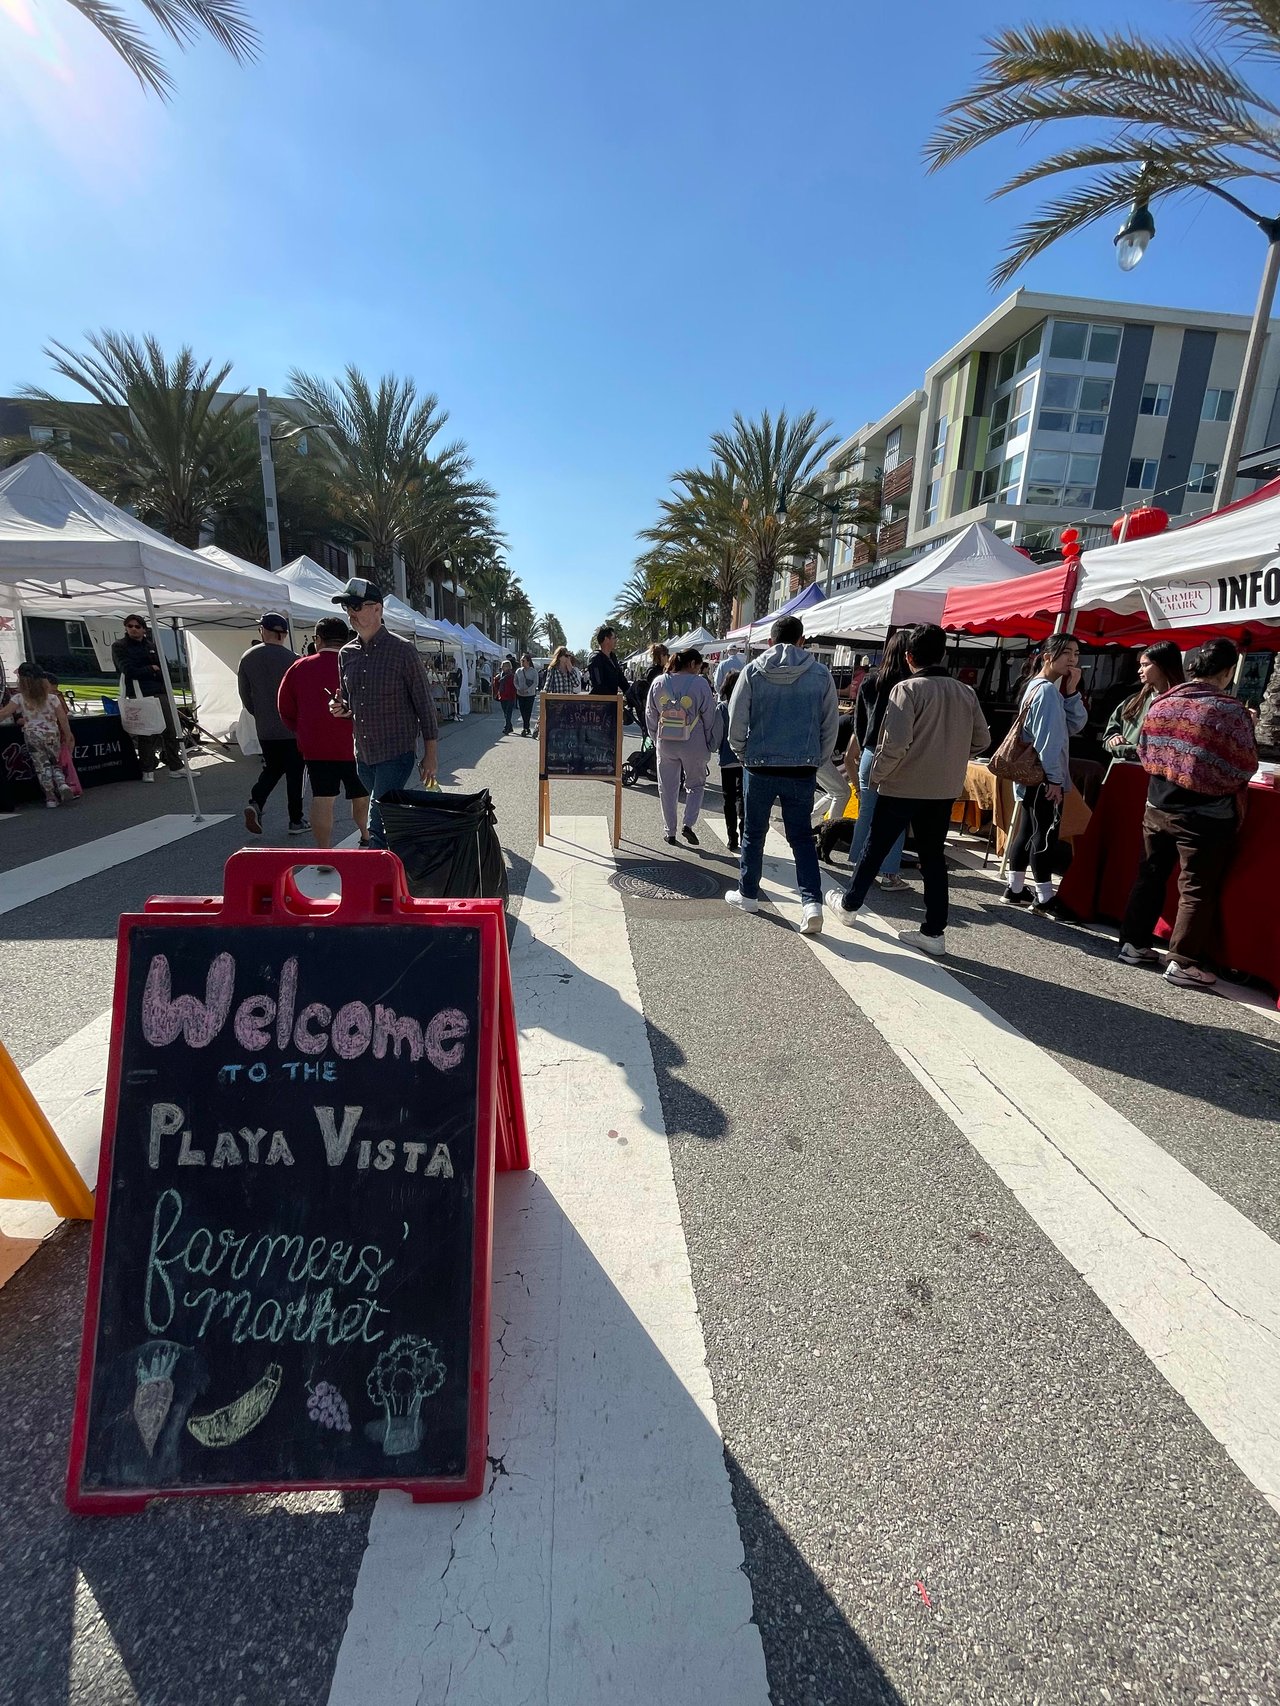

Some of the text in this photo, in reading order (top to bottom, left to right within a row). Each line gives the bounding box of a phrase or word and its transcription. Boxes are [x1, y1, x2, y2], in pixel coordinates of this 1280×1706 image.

[1217, 567, 1280, 612] INFO
[71, 740, 121, 759] EZ TEAM
[141, 952, 470, 1072] Welcome
[222, 1061, 339, 1083] TO THE
[184, 1287, 392, 1345] market
